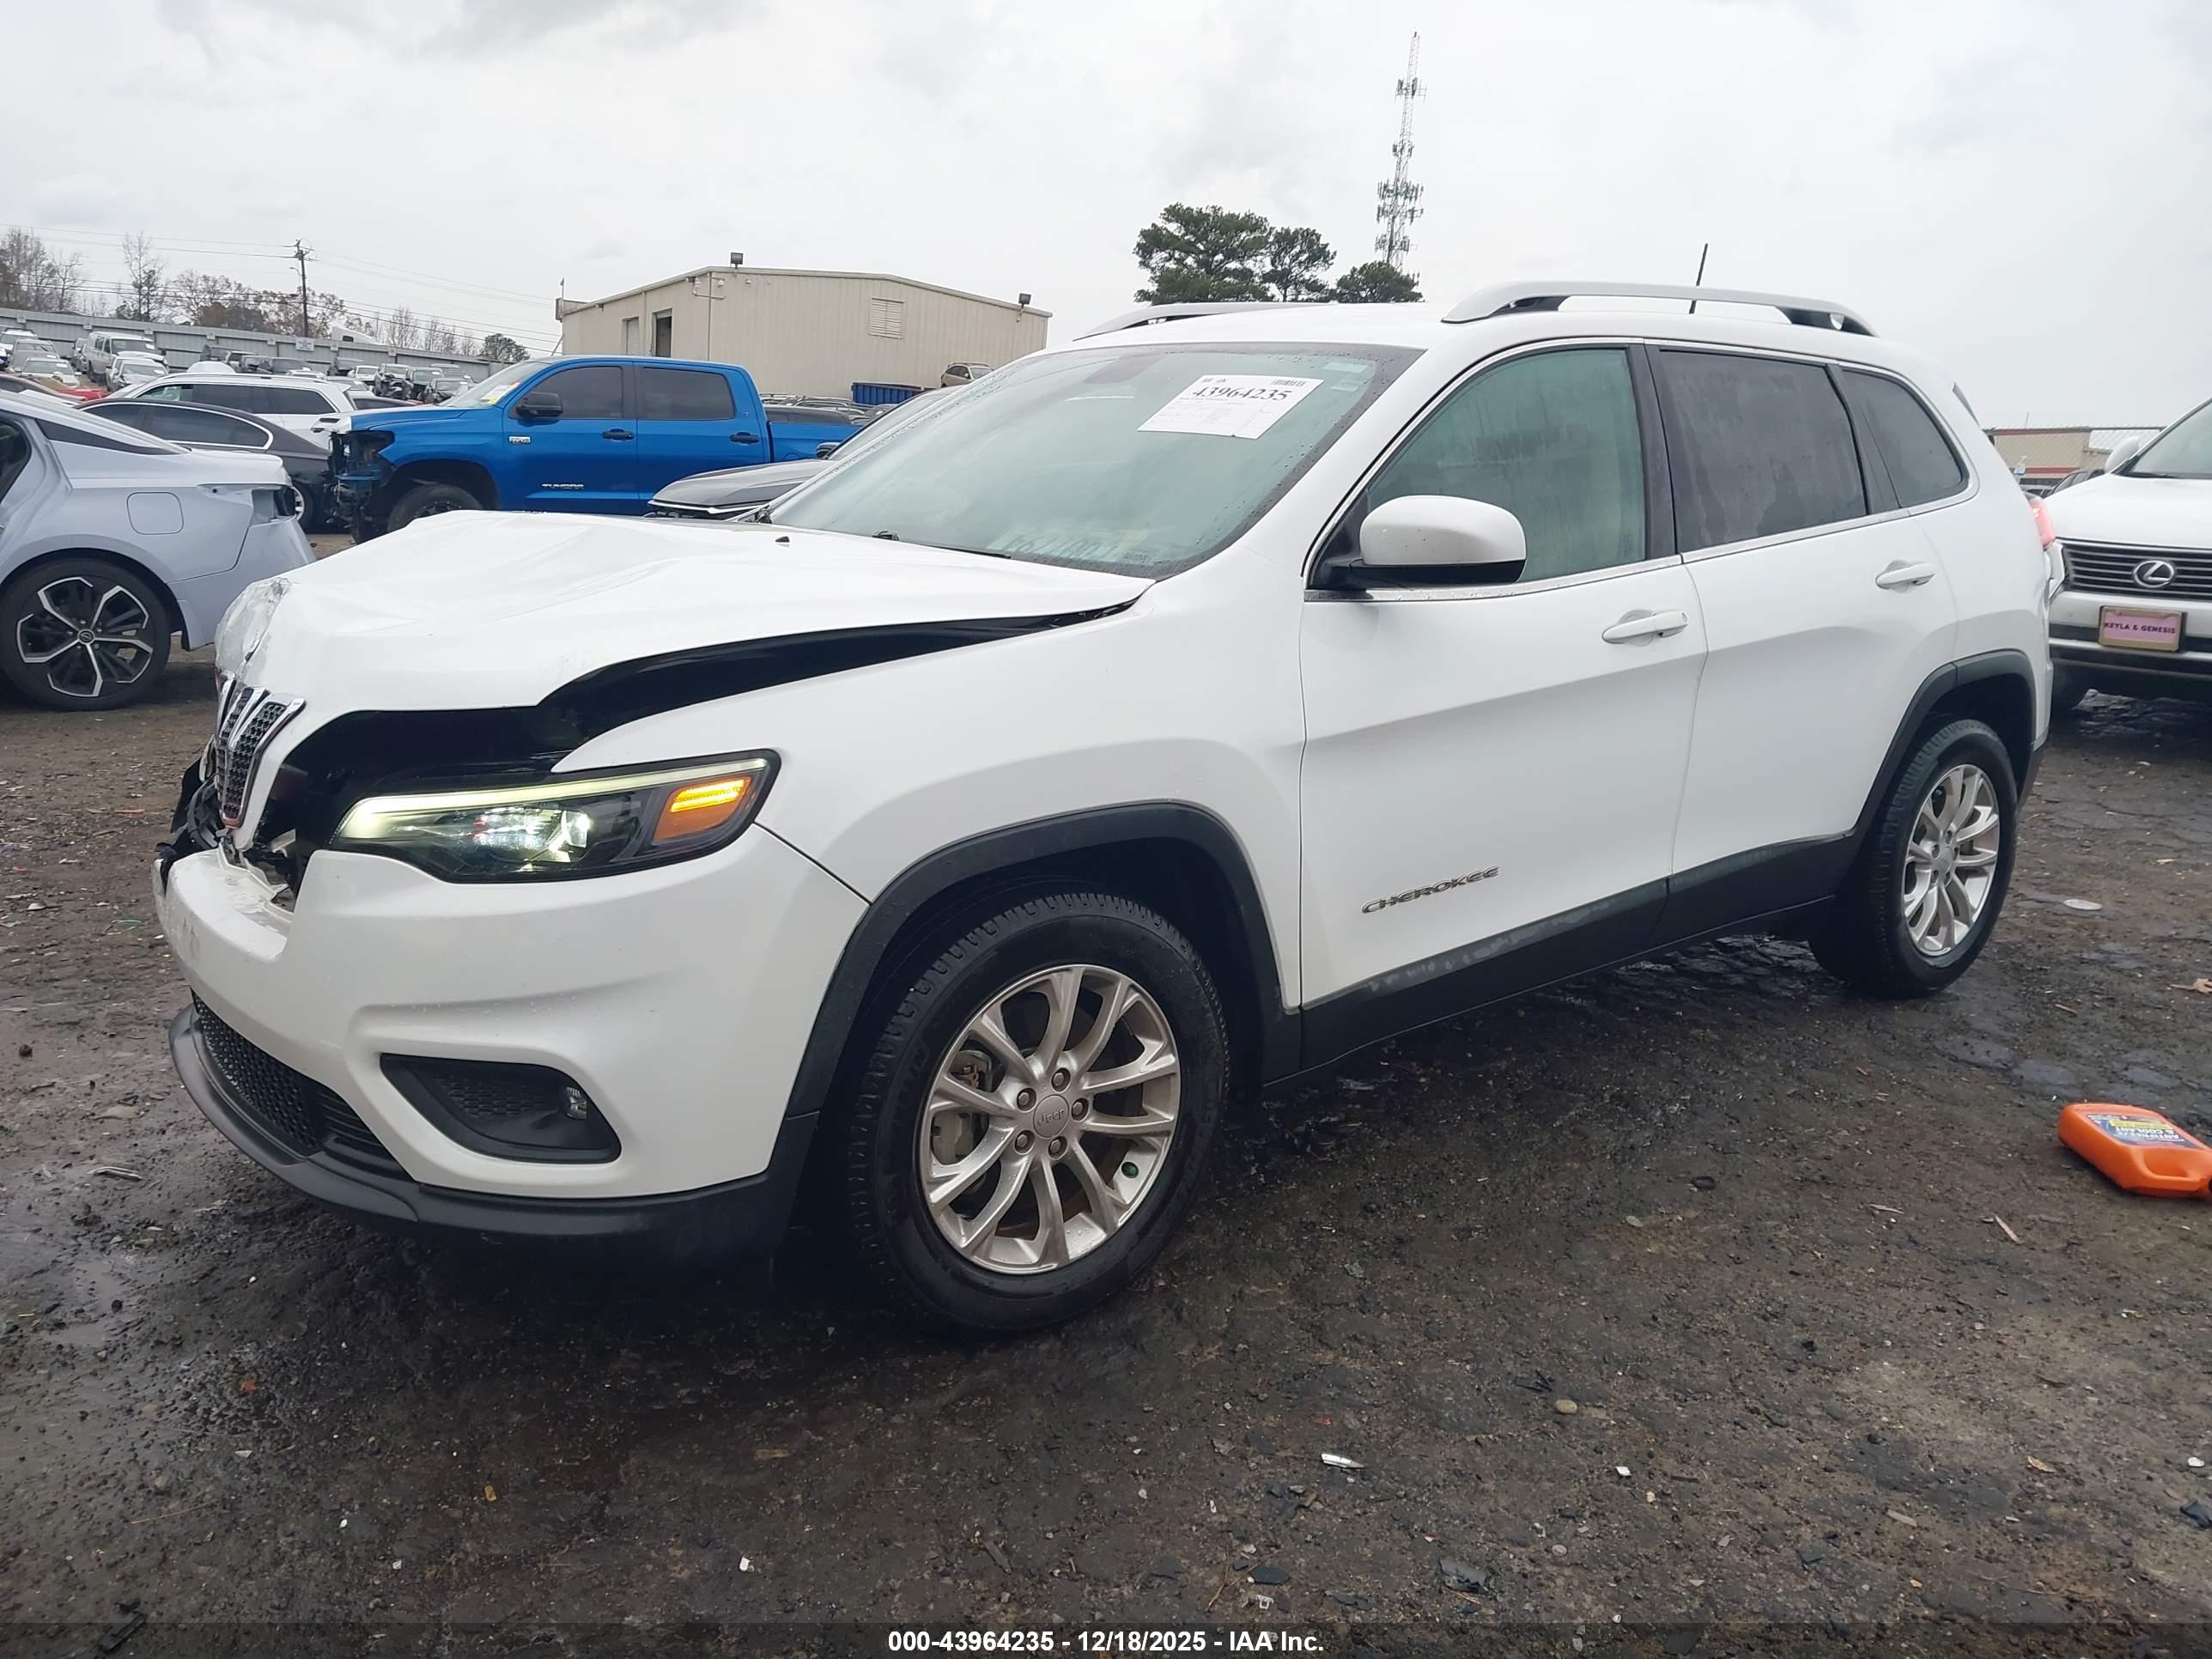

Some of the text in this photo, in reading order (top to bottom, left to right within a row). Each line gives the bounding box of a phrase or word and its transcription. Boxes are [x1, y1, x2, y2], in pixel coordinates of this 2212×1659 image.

[1192, 386, 1292, 401] 43964235
[2141, 625, 2176, 634] GENESIS
[1361, 866, 1500, 914] CHEROKEE
[1036, 1109, 1065, 1124] Jeep
